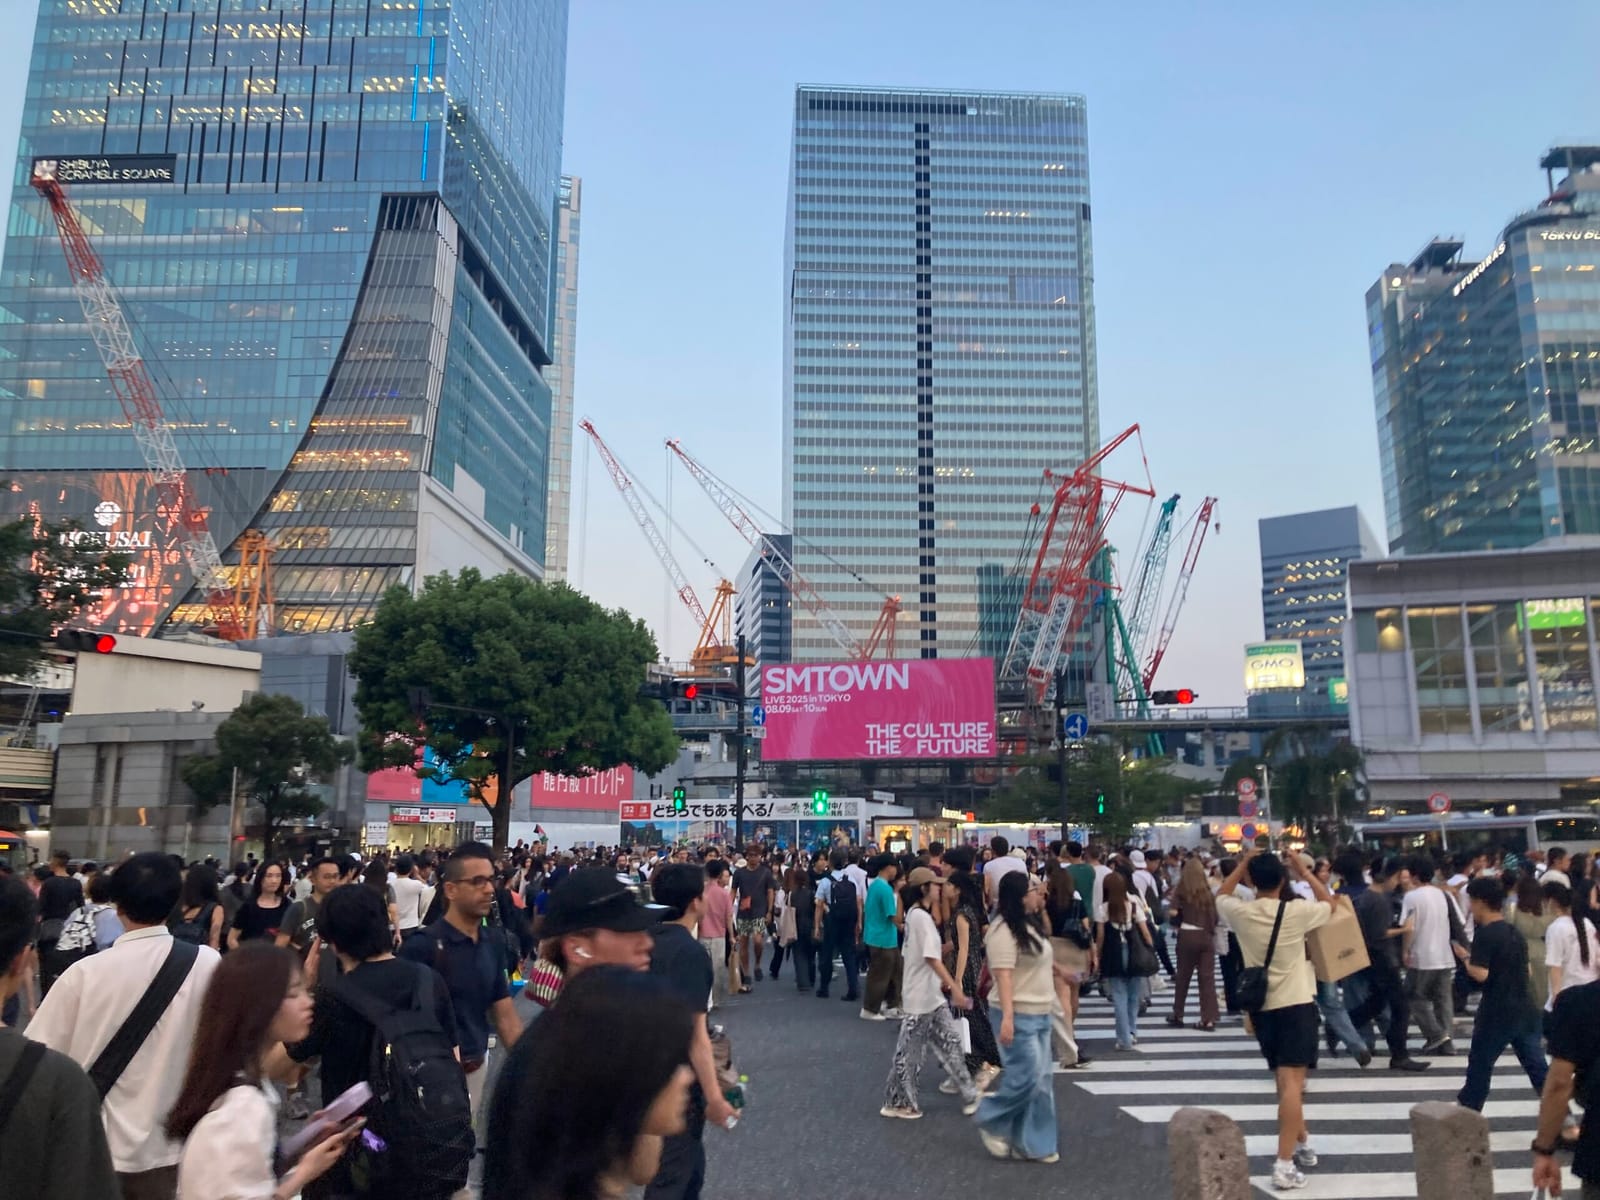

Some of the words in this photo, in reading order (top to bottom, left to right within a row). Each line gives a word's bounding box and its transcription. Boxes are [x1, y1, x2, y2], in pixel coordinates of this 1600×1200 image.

[59, 159, 110, 170] SHIBUYA
[58, 170, 120, 180] SCRAMBLE
[122, 168, 171, 179] SQUARE
[1541, 230, 1582, 240] TOKYU
[1460, 241, 1506, 290] FUKURAS
[1251, 658, 1294, 670] GMO
[765, 663, 909, 694] SMTOWN
[765, 695, 785, 704] LIVE
[786, 694, 808, 704] 2025
[809, 693, 817, 703] in
[818, 693, 851, 703] TOKYO
[865, 723, 901, 739] THE
[903, 721, 993, 740] CULTURE,
[865, 739, 902, 754] THE
[916, 738, 990, 754] FUTURE
